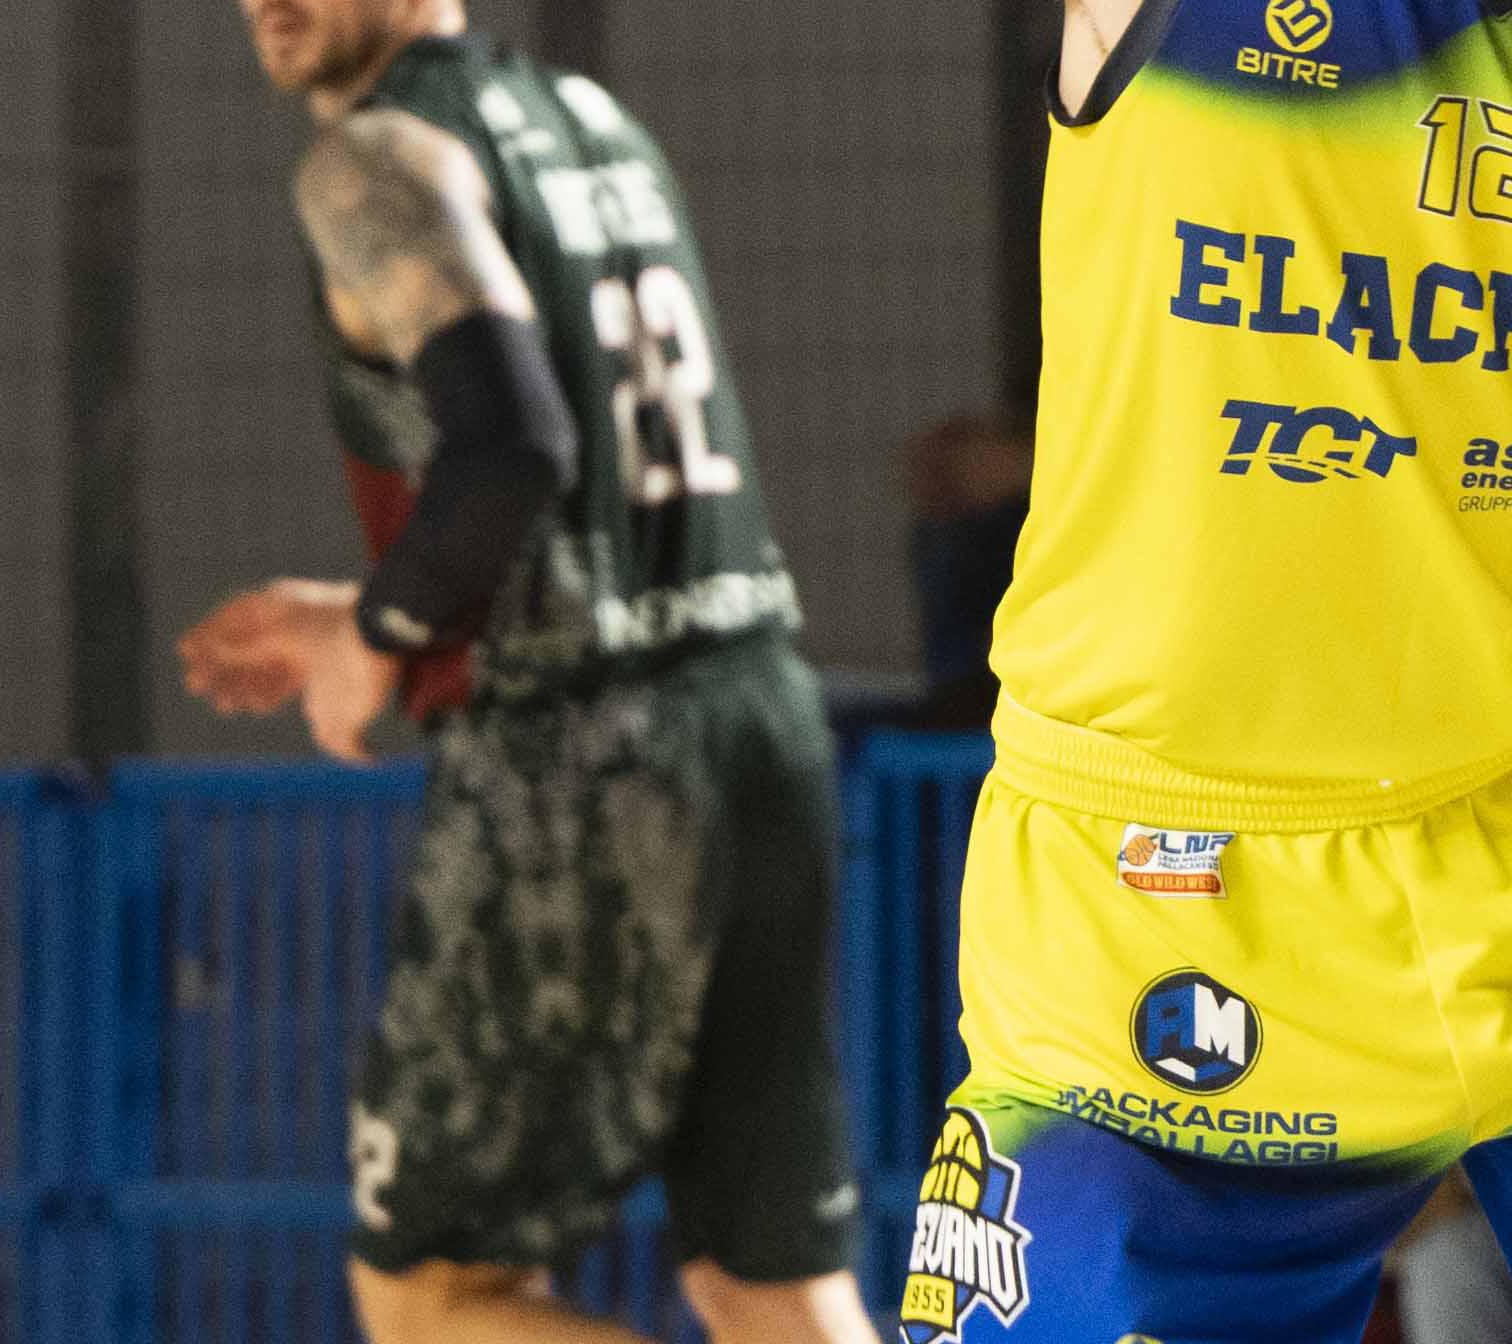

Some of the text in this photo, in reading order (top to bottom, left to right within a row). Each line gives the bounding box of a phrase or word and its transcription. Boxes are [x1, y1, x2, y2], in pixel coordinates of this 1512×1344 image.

[1236, 47, 1342, 89] BITRE
[1159, 831, 1234, 854] LNP
[910, 1284, 947, 1313] 955
